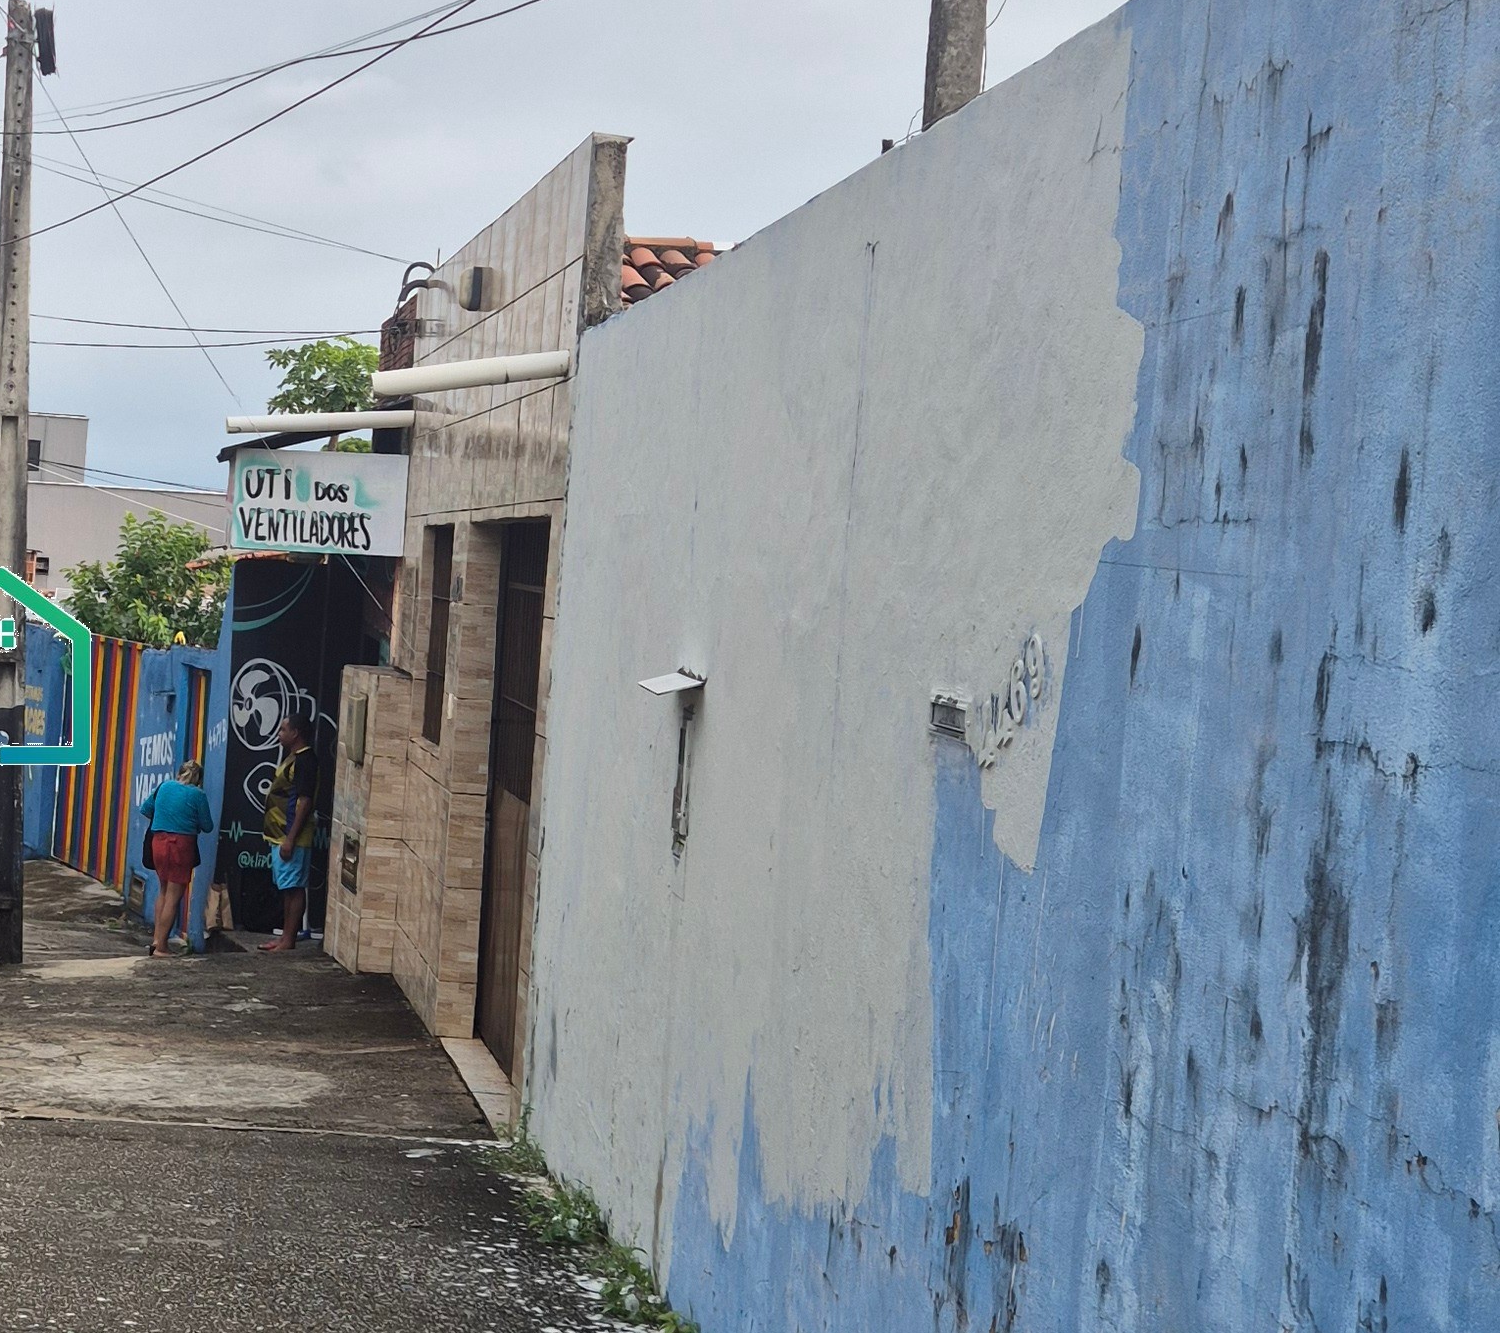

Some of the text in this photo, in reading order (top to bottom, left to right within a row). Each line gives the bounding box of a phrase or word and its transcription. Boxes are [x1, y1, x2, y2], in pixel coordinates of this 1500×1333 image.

[244, 468, 350, 503] UTI DOS
[238, 506, 372, 551] VENTILADORES
[139, 730, 174, 767] TEMOS
